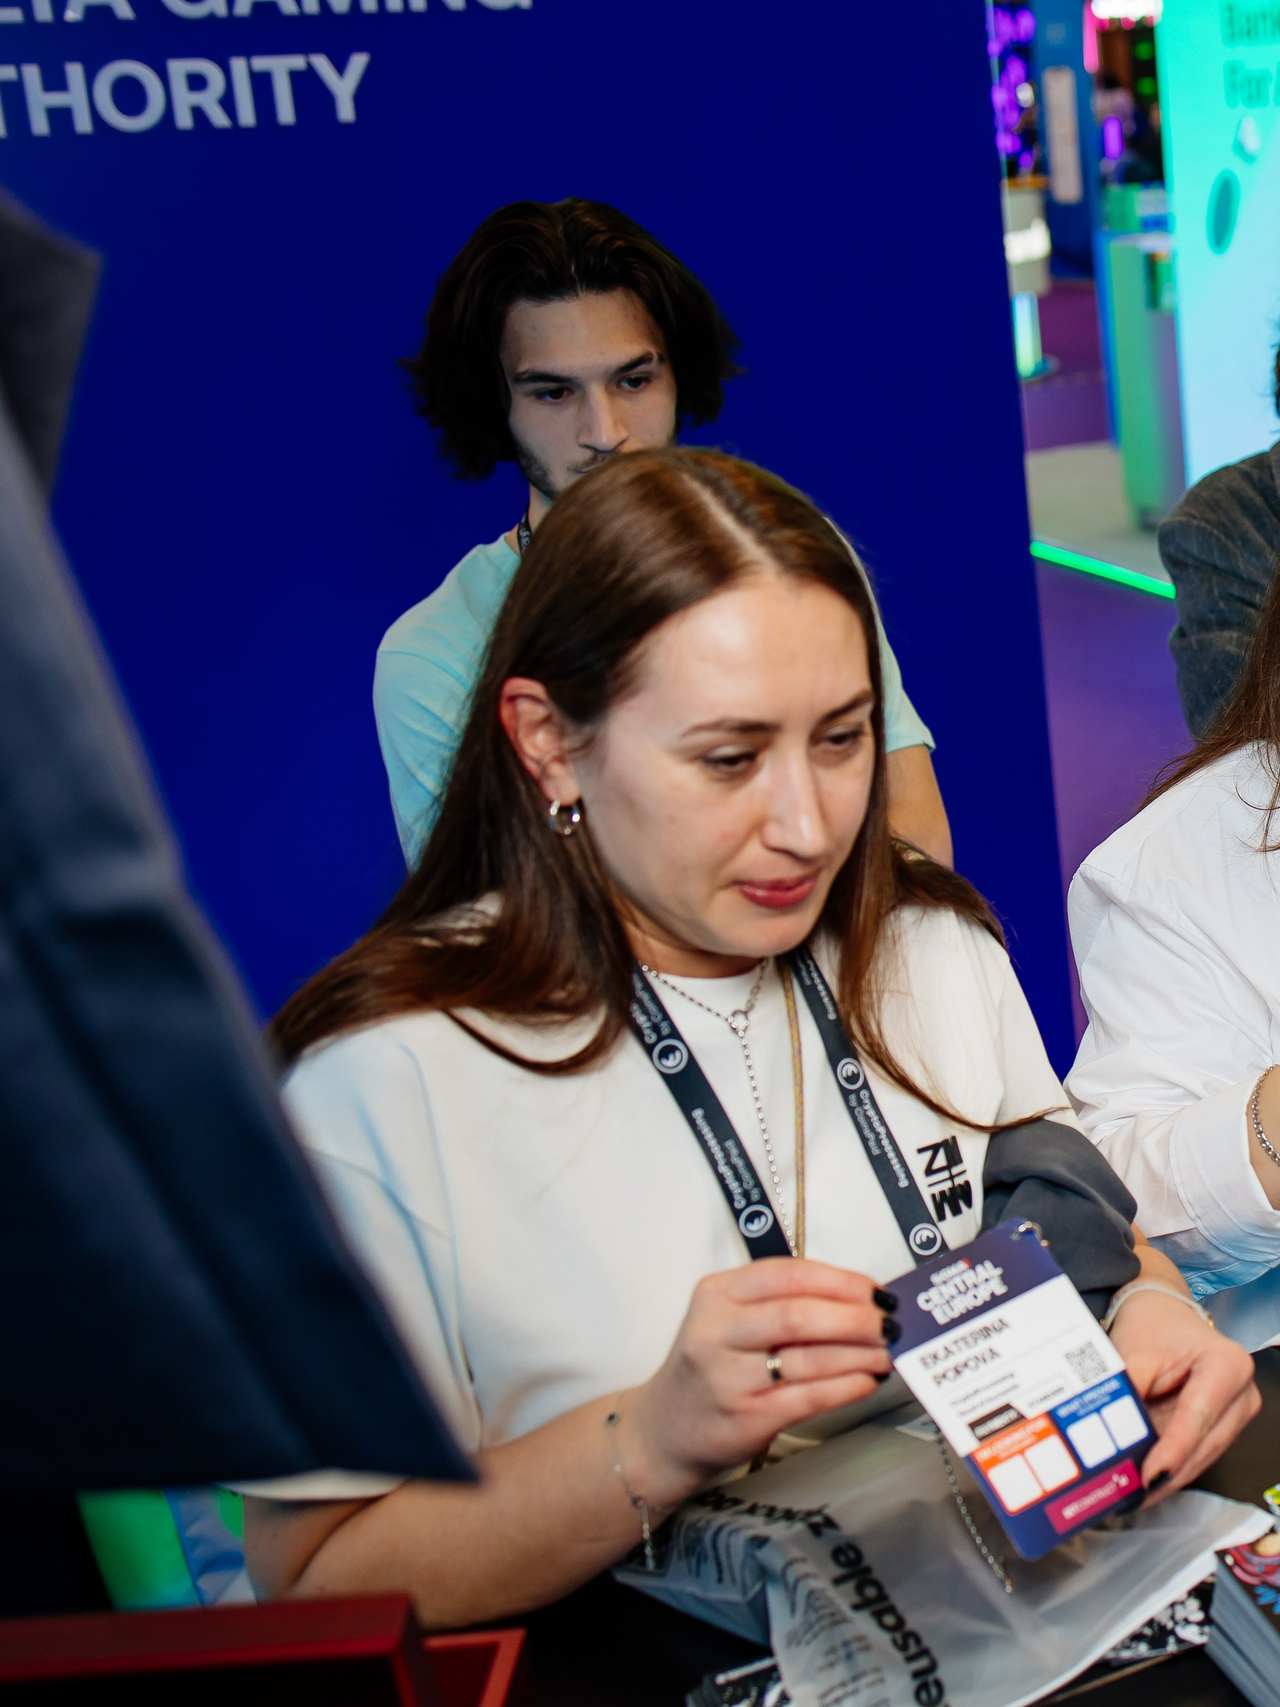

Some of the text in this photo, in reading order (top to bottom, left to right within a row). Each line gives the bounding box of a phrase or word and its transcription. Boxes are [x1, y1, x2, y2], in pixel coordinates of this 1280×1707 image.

[1223, 60, 1272, 108] For
[691, 1107, 747, 1209] CryptoProcessing
[861, 1089, 909, 1188] CryptoProcessing
[917, 1260, 1003, 1311] CENTRAL
[931, 1276, 1008, 1325] EUROPE
[920, 1318, 1010, 1369] EKATERINA
[932, 1347, 1000, 1388] POPOVA
[830, 1541, 946, 1707] eusable
